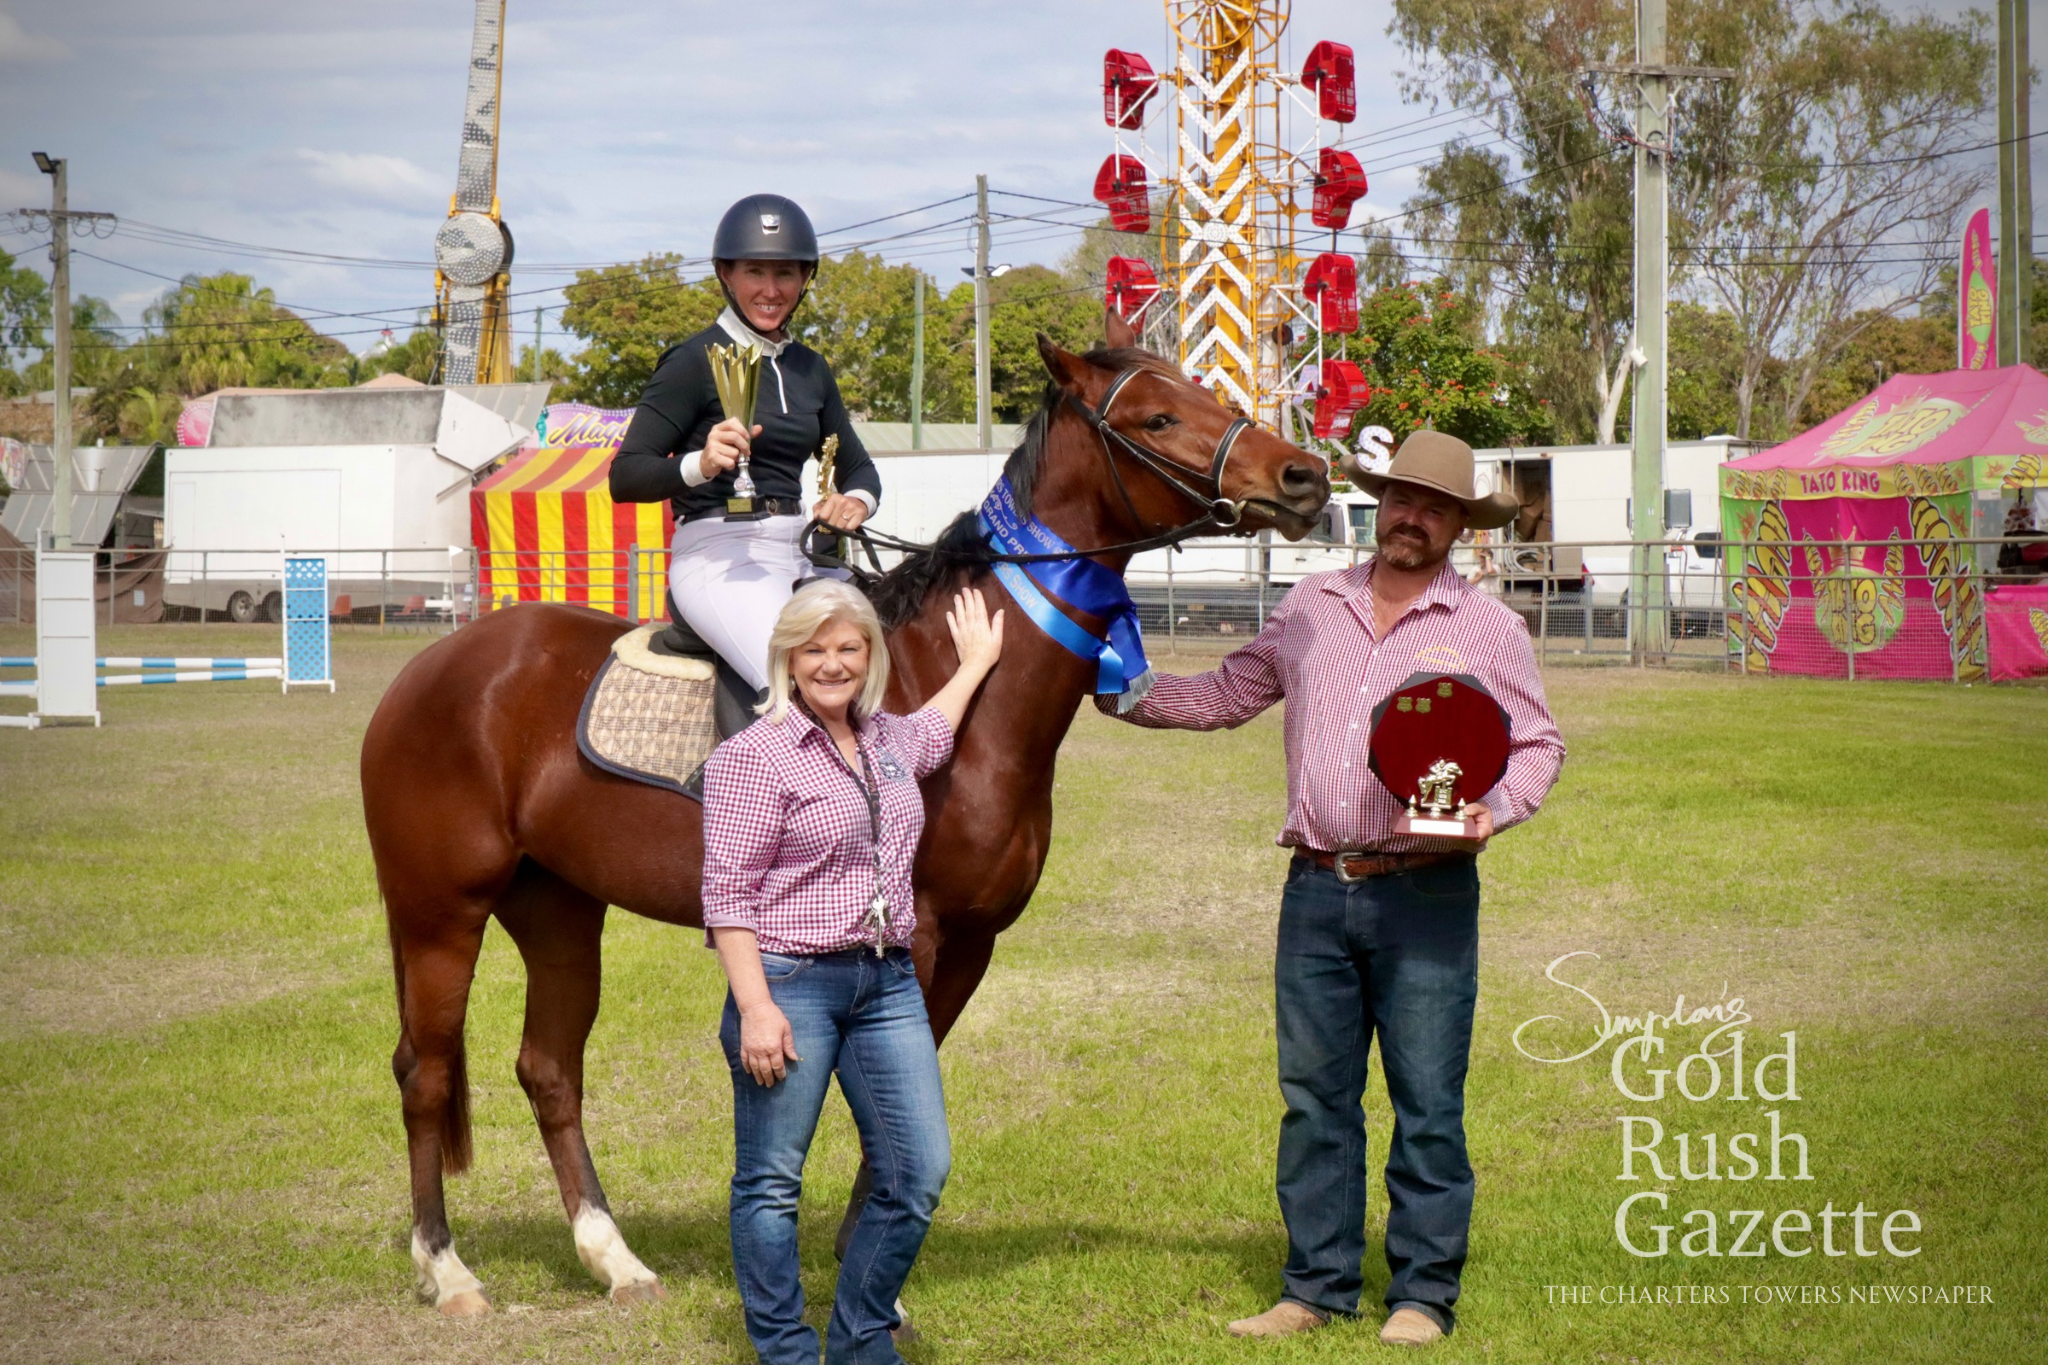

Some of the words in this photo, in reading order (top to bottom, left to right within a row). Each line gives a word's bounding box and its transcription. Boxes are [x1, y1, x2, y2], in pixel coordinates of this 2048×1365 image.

[547, 411, 628, 447] Magi
[1800, 471, 1836, 494] TATO
[1841, 471, 1880, 493] KING
[983, 500, 1009, 538] GRAND
[1027, 522, 1055, 549] SHOW
[1010, 574, 1039, 609] SHOW
